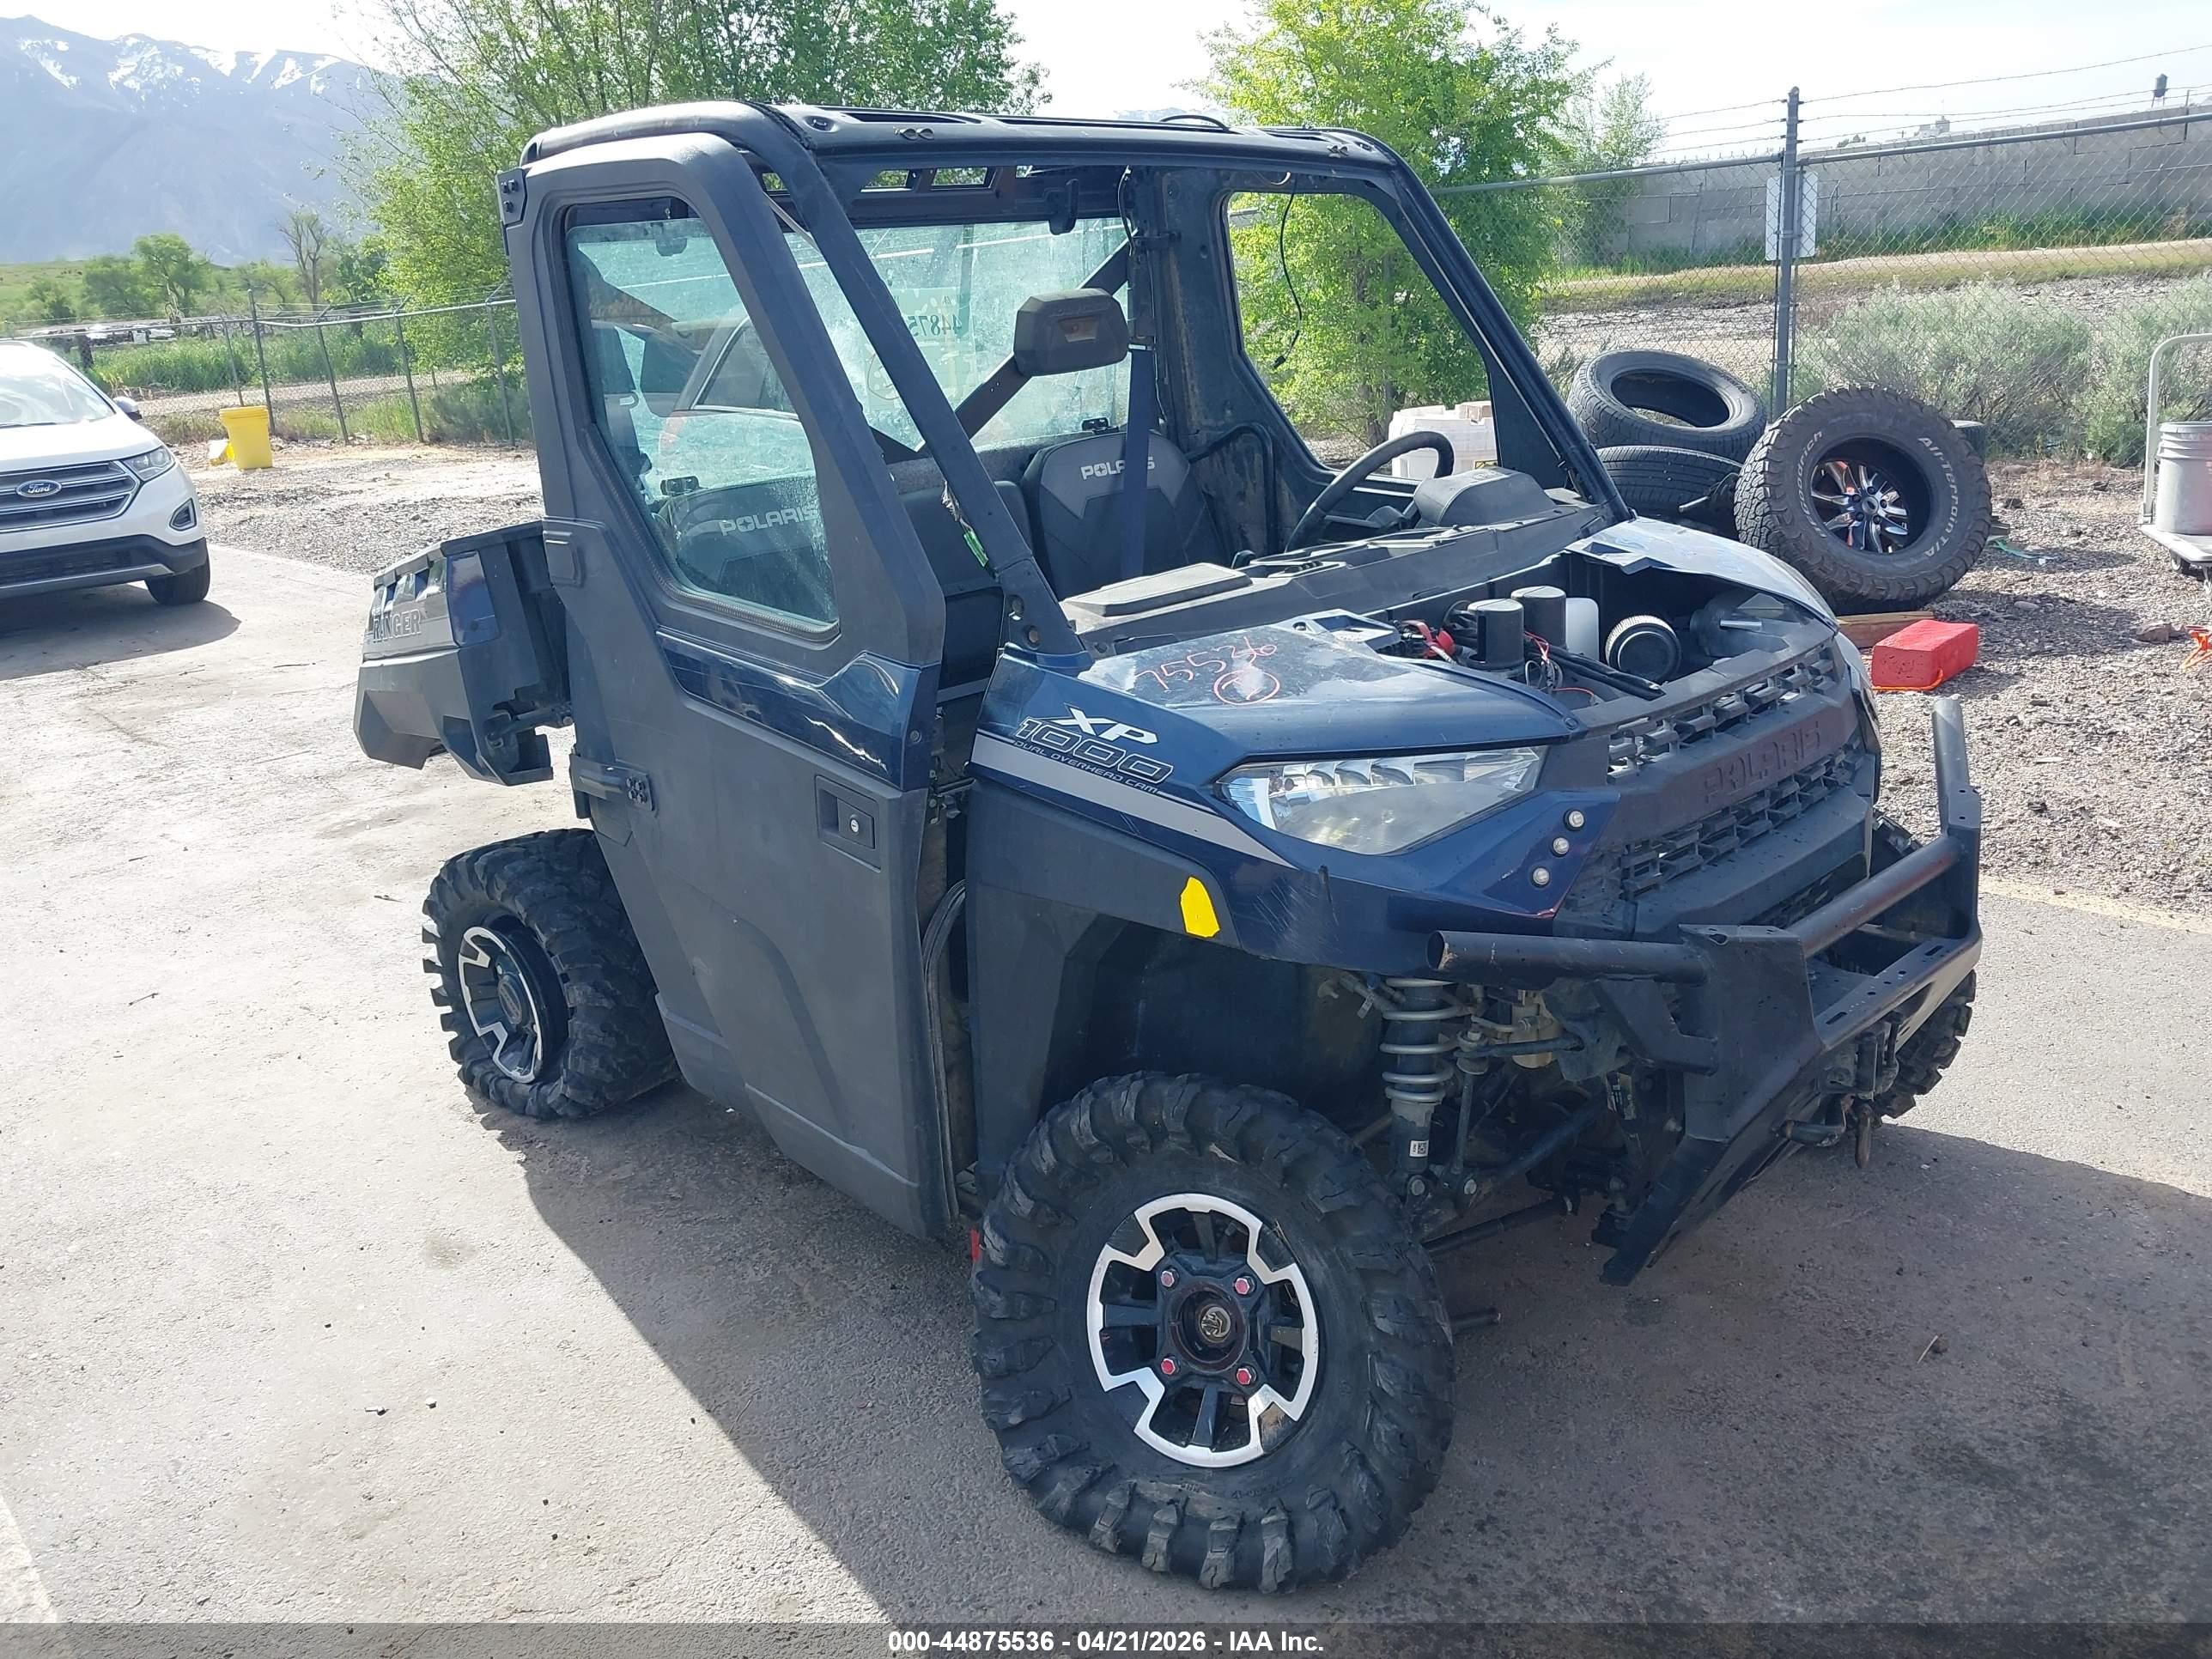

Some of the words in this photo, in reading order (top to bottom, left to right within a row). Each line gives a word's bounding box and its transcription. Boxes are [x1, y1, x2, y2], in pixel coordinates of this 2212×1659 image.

[1080, 456, 1156, 481] POLAS
[718, 505, 820, 537] POLARIS
[372, 608, 422, 643] RANGER
[1049, 703, 1159, 745] XP
[1013, 740, 1048, 757] DUAL
[1050, 752, 1123, 782] OVERHEAD
[1124, 777, 1158, 795] CAM
[1014, 717, 1175, 785] 1000
[1704, 720, 1821, 805] POLARIS
